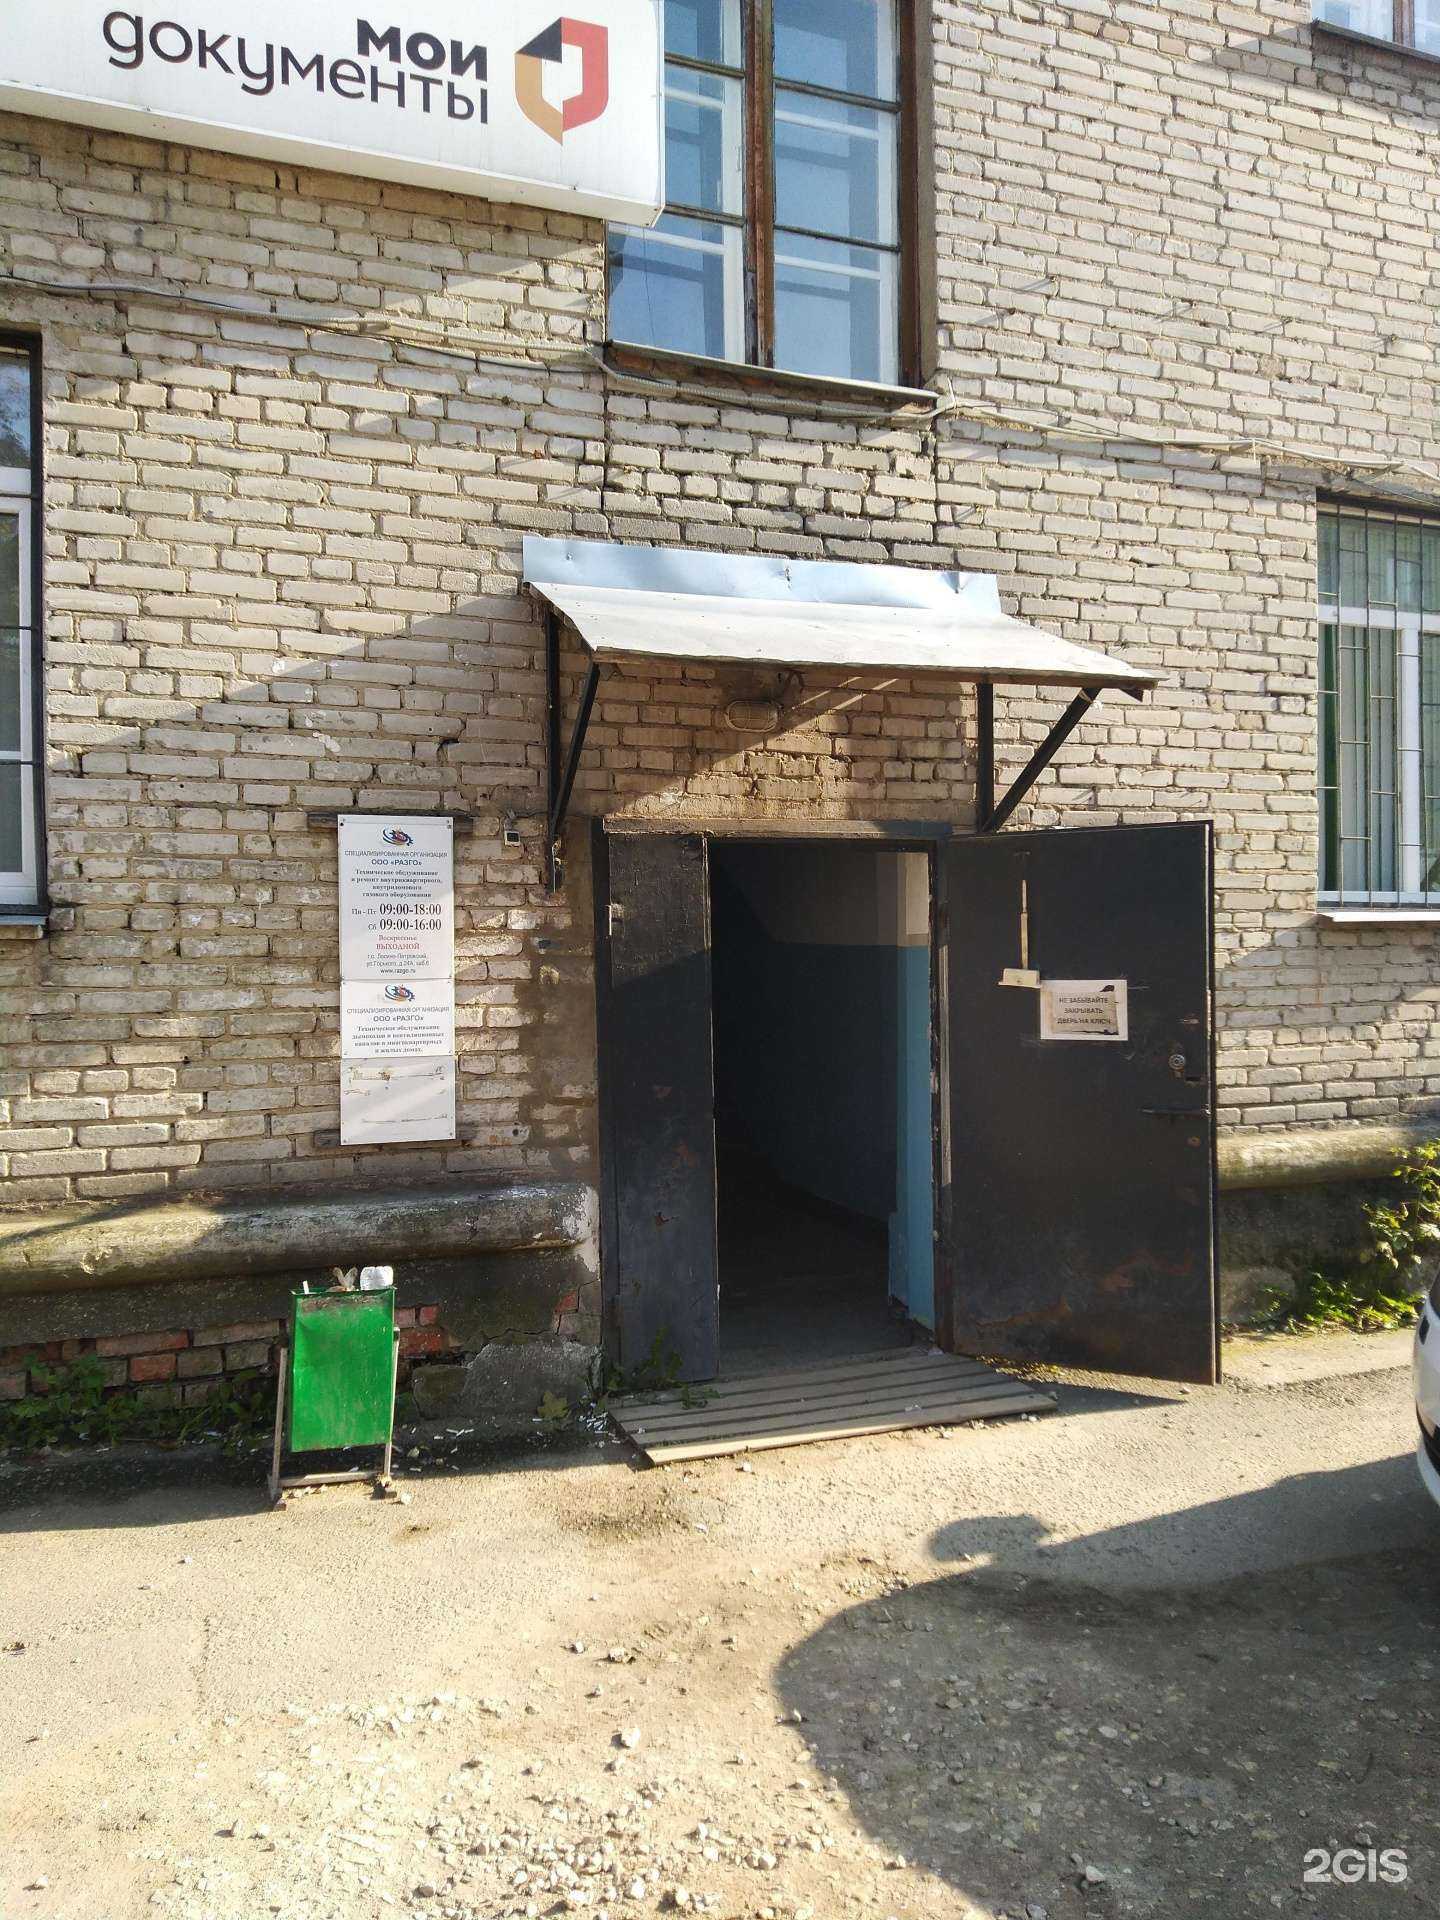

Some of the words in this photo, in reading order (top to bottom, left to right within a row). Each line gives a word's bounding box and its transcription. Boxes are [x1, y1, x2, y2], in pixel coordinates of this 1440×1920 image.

[102, 11, 488, 124] документы
[395, 869, 439, 877] обслуживание
[379, 903, 442, 915] 09:00-18:00
[379, 919, 442, 930] 09:00-16:00
[378, 934, 418, 942] Воскресенье
[1069, 996, 1108, 1004] ЗАБЫВАЙТЕ
